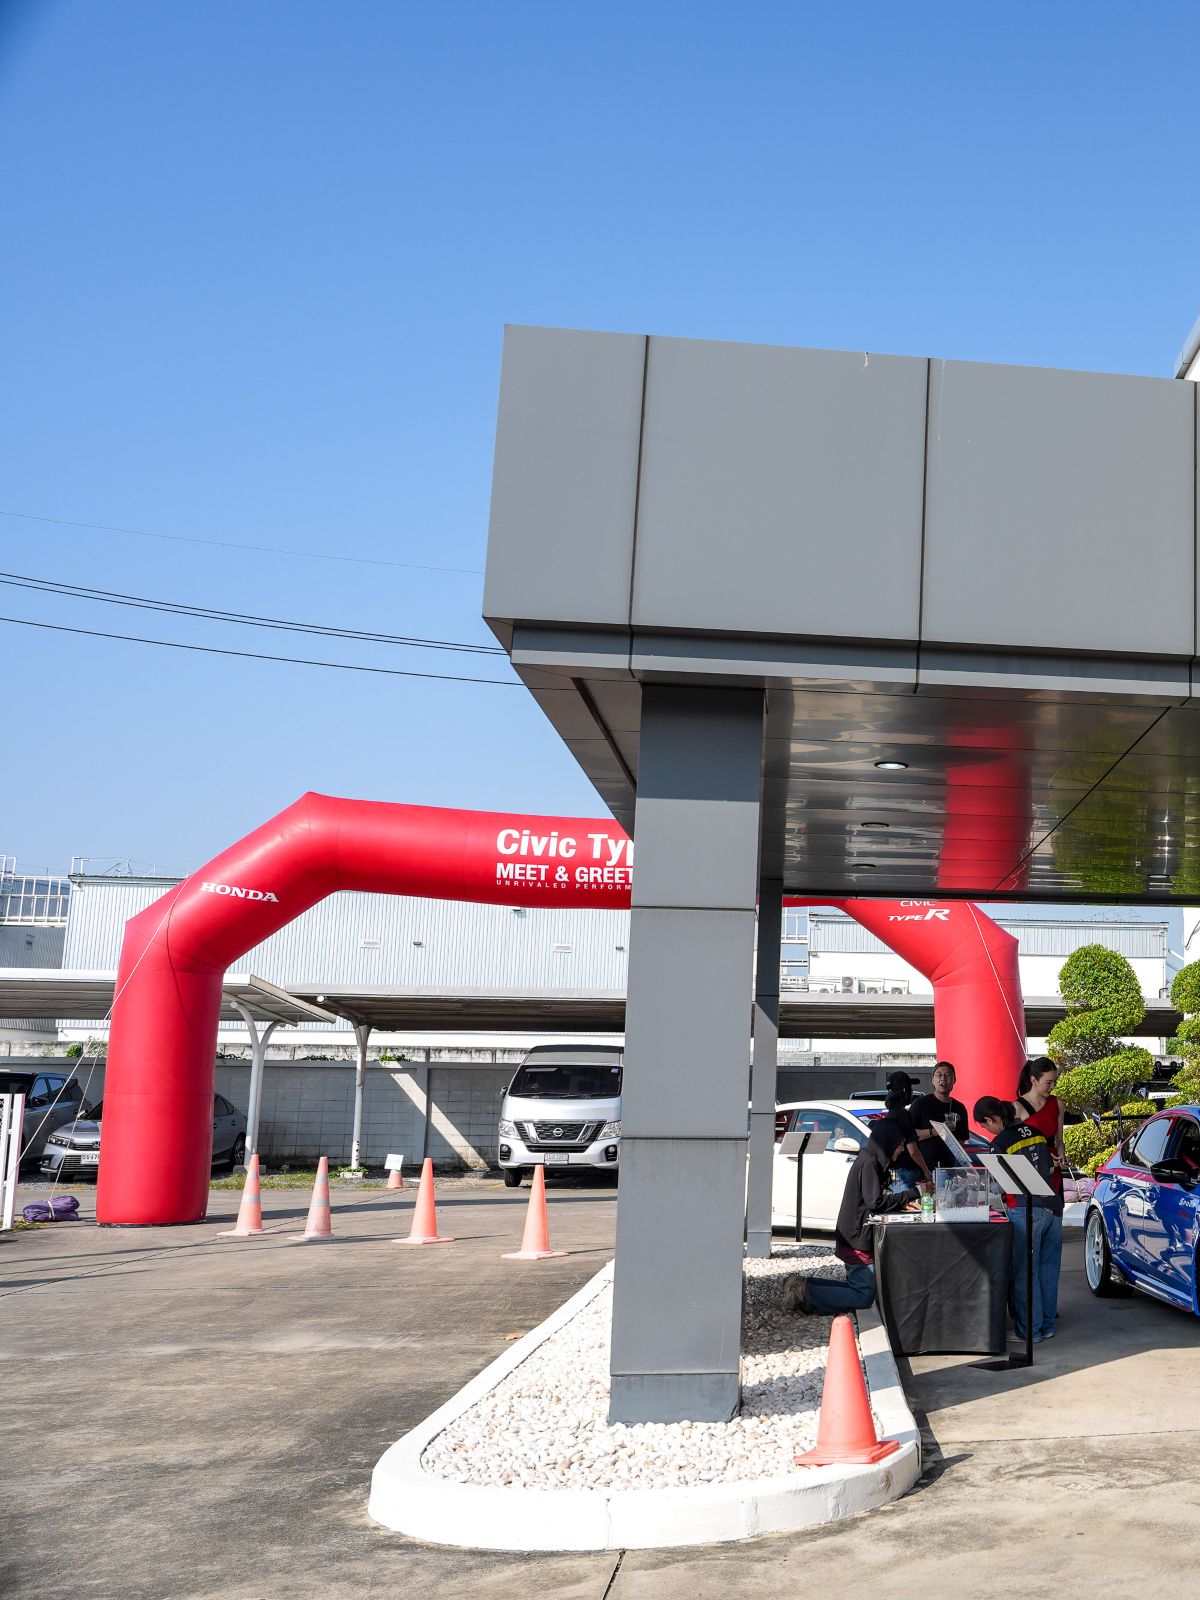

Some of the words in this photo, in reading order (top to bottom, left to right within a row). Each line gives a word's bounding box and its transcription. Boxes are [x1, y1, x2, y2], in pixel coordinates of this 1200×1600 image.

[496, 828, 577, 858] Civic
[496, 862, 550, 881] MEET
[554, 865, 570, 882] &
[575, 866, 634, 884] GREET
[200, 881, 280, 903] HONDA
[496, 880, 567, 889] UNRIVALED
[1018, 1126, 1032, 1138] 35
